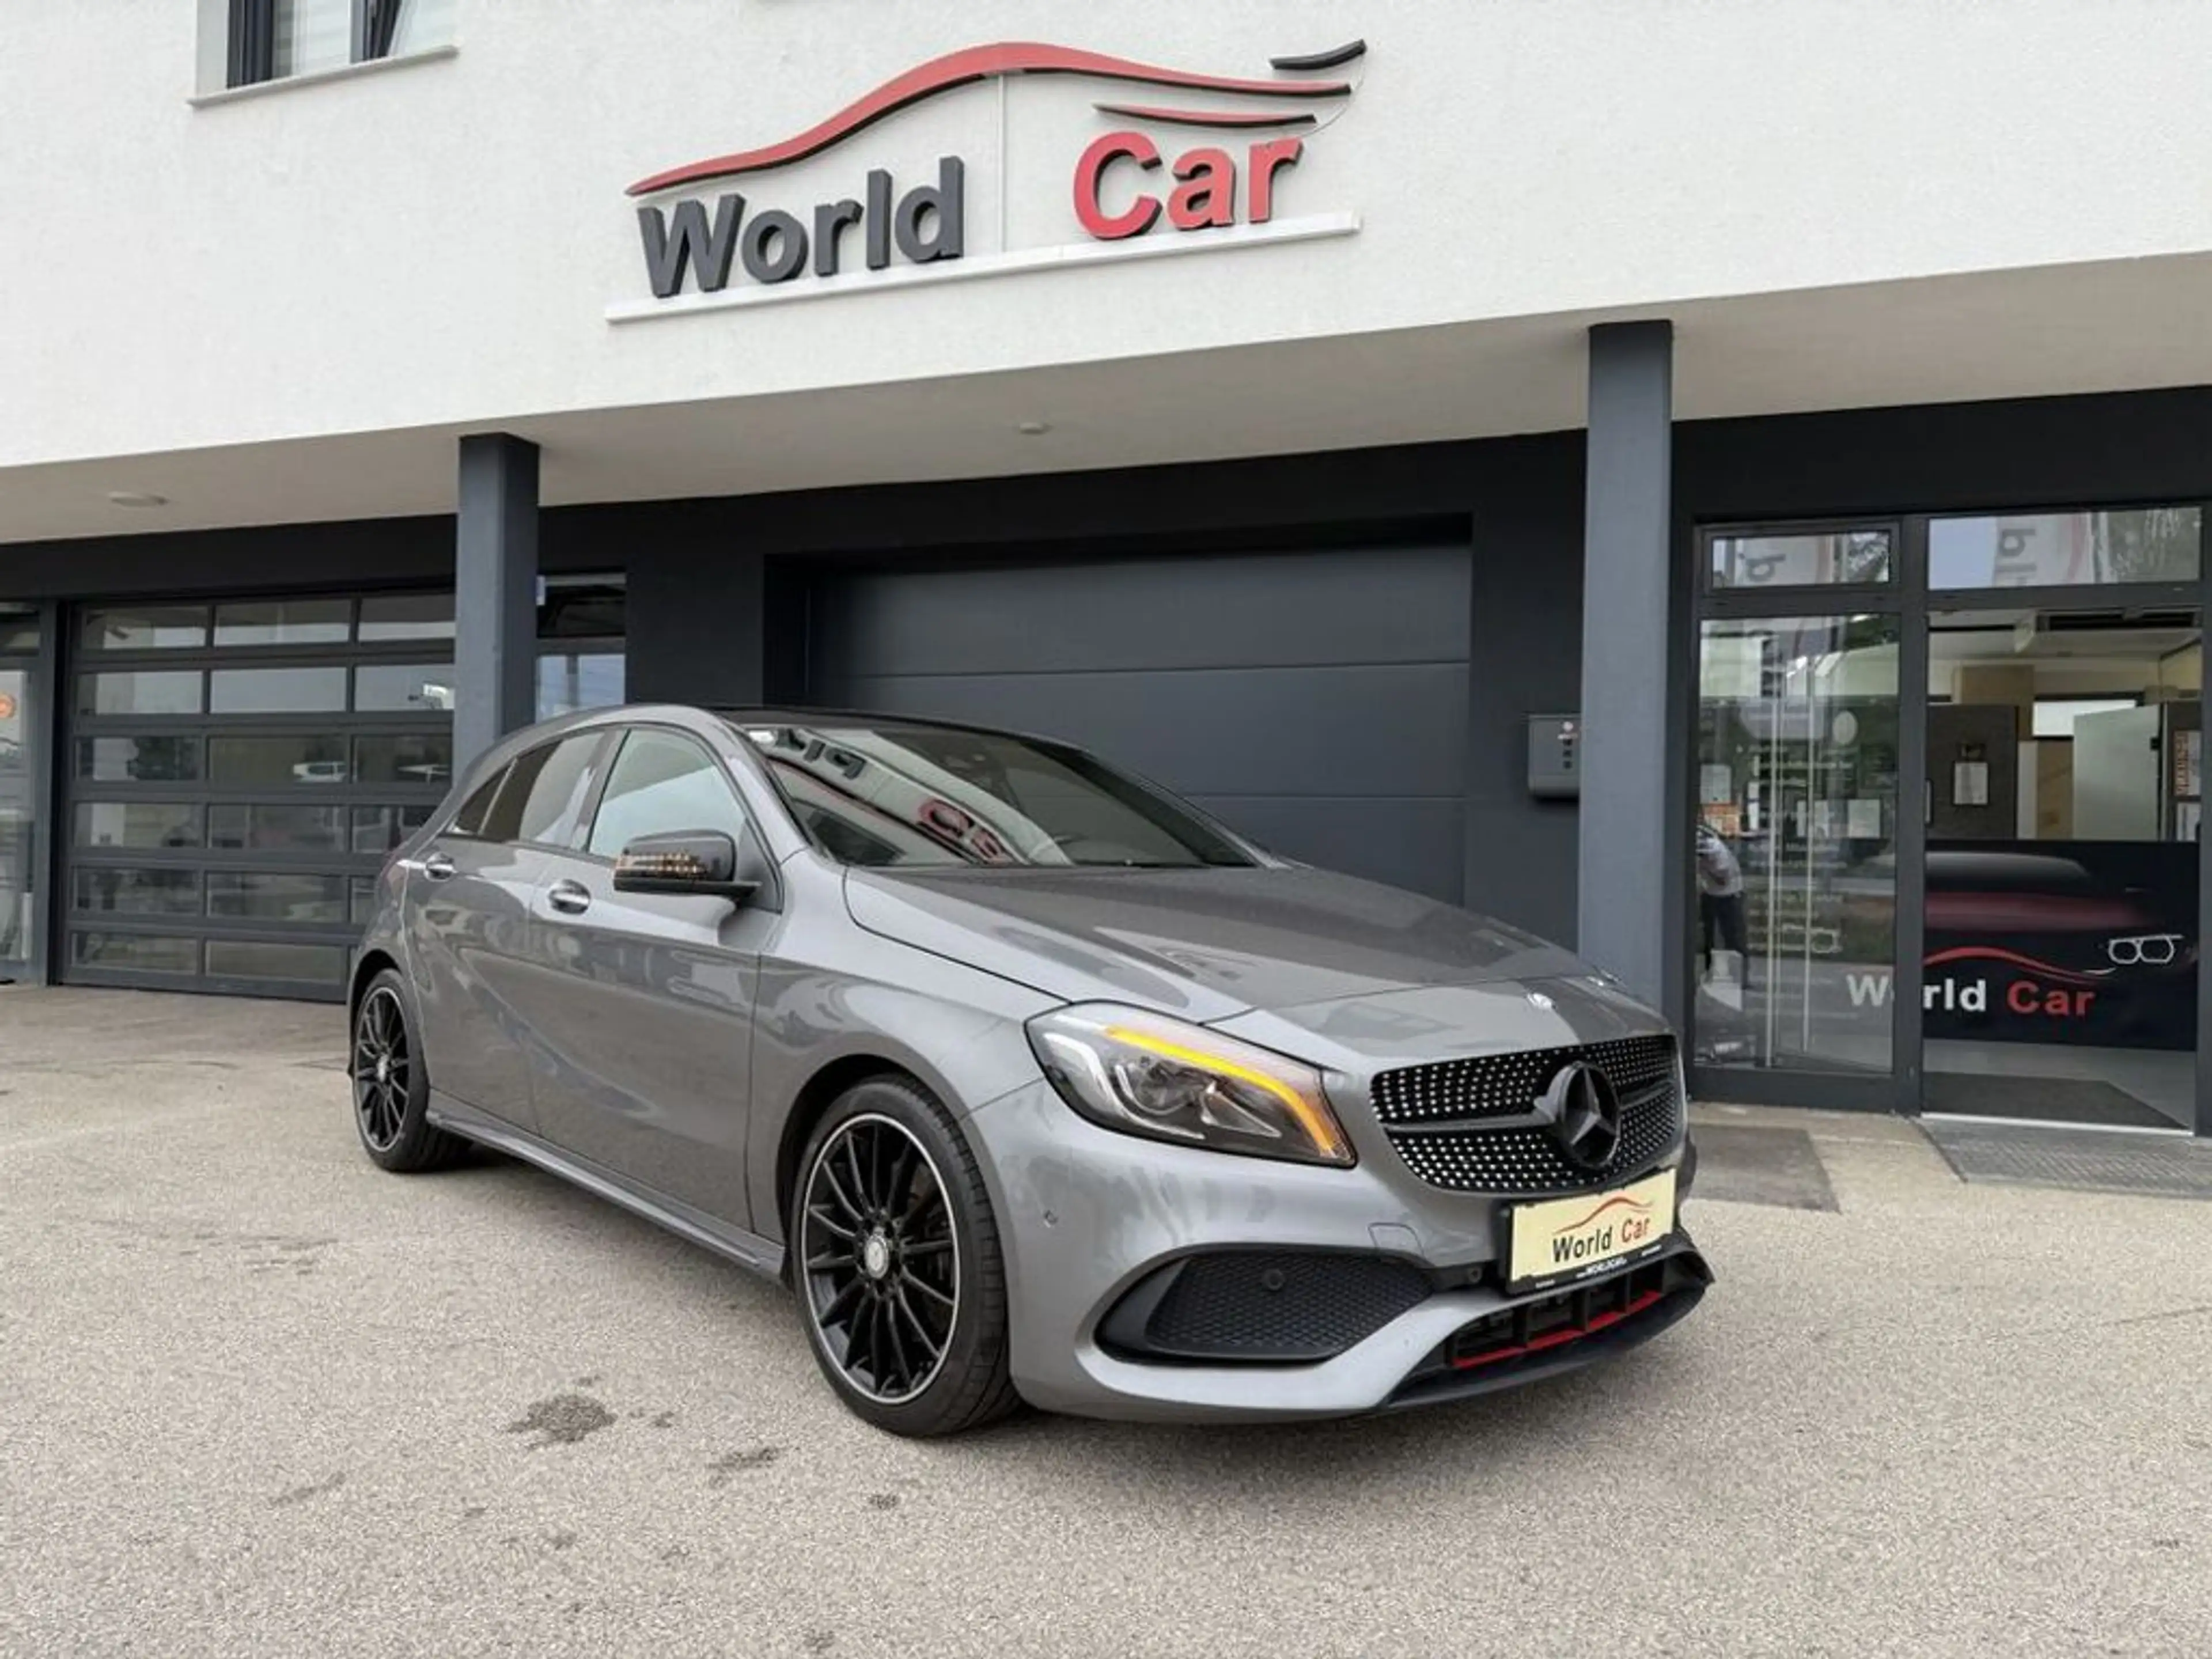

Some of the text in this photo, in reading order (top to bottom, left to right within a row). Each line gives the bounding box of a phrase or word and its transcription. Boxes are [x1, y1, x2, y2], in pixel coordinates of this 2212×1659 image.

[637, 131, 1302, 298] World Car
[1846, 974, 2096, 1015] Wrld Car
[1552, 1217, 1650, 1263] World Car
